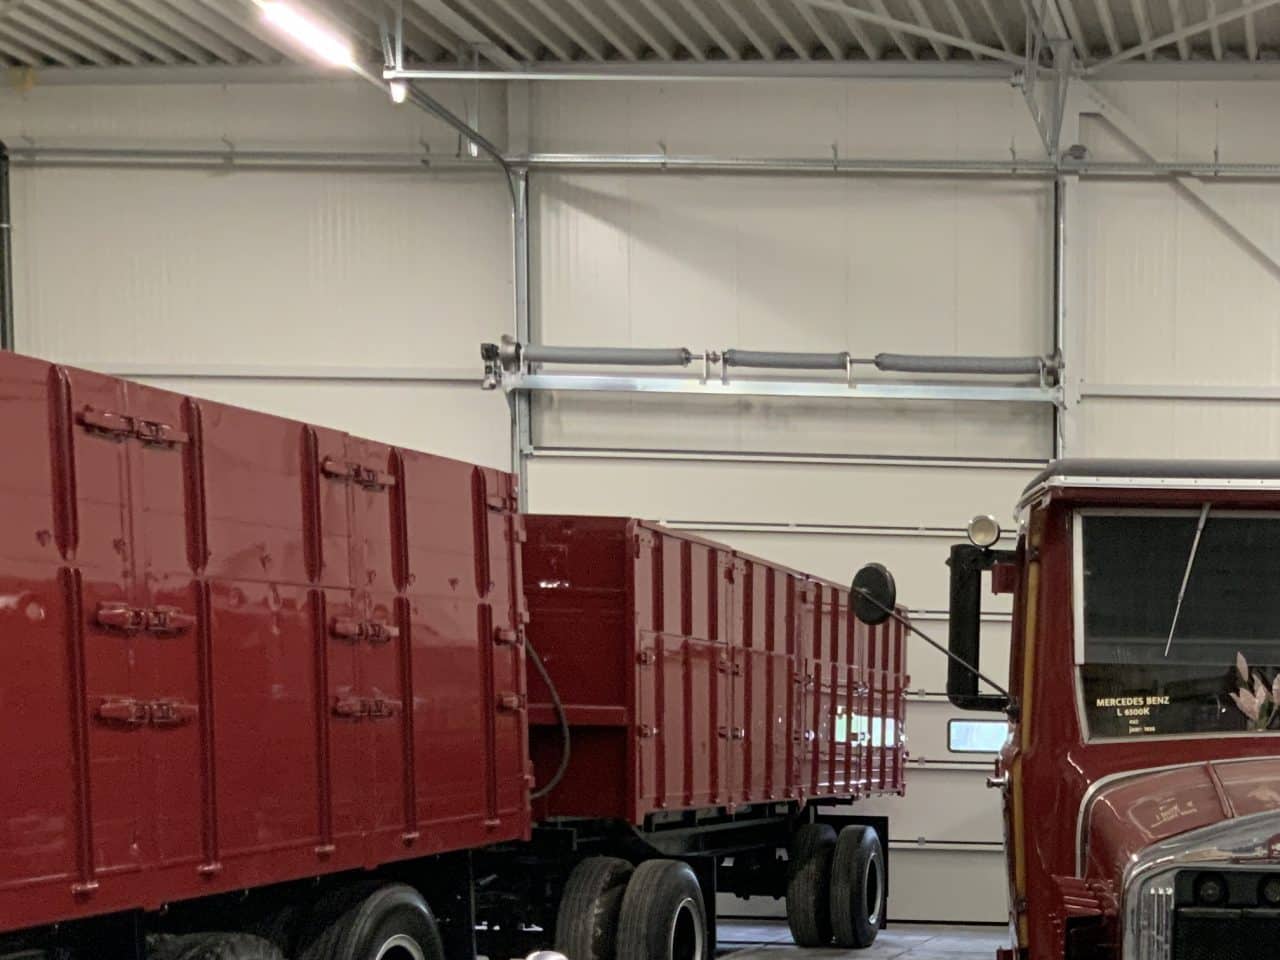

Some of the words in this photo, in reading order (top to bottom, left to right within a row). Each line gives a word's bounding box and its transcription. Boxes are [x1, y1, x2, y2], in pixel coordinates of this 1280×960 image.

[1096, 697, 1144, 707] MERCEDES
[1146, 696, 1170, 705] BENZ
[1116, 708, 1122, 716] L
